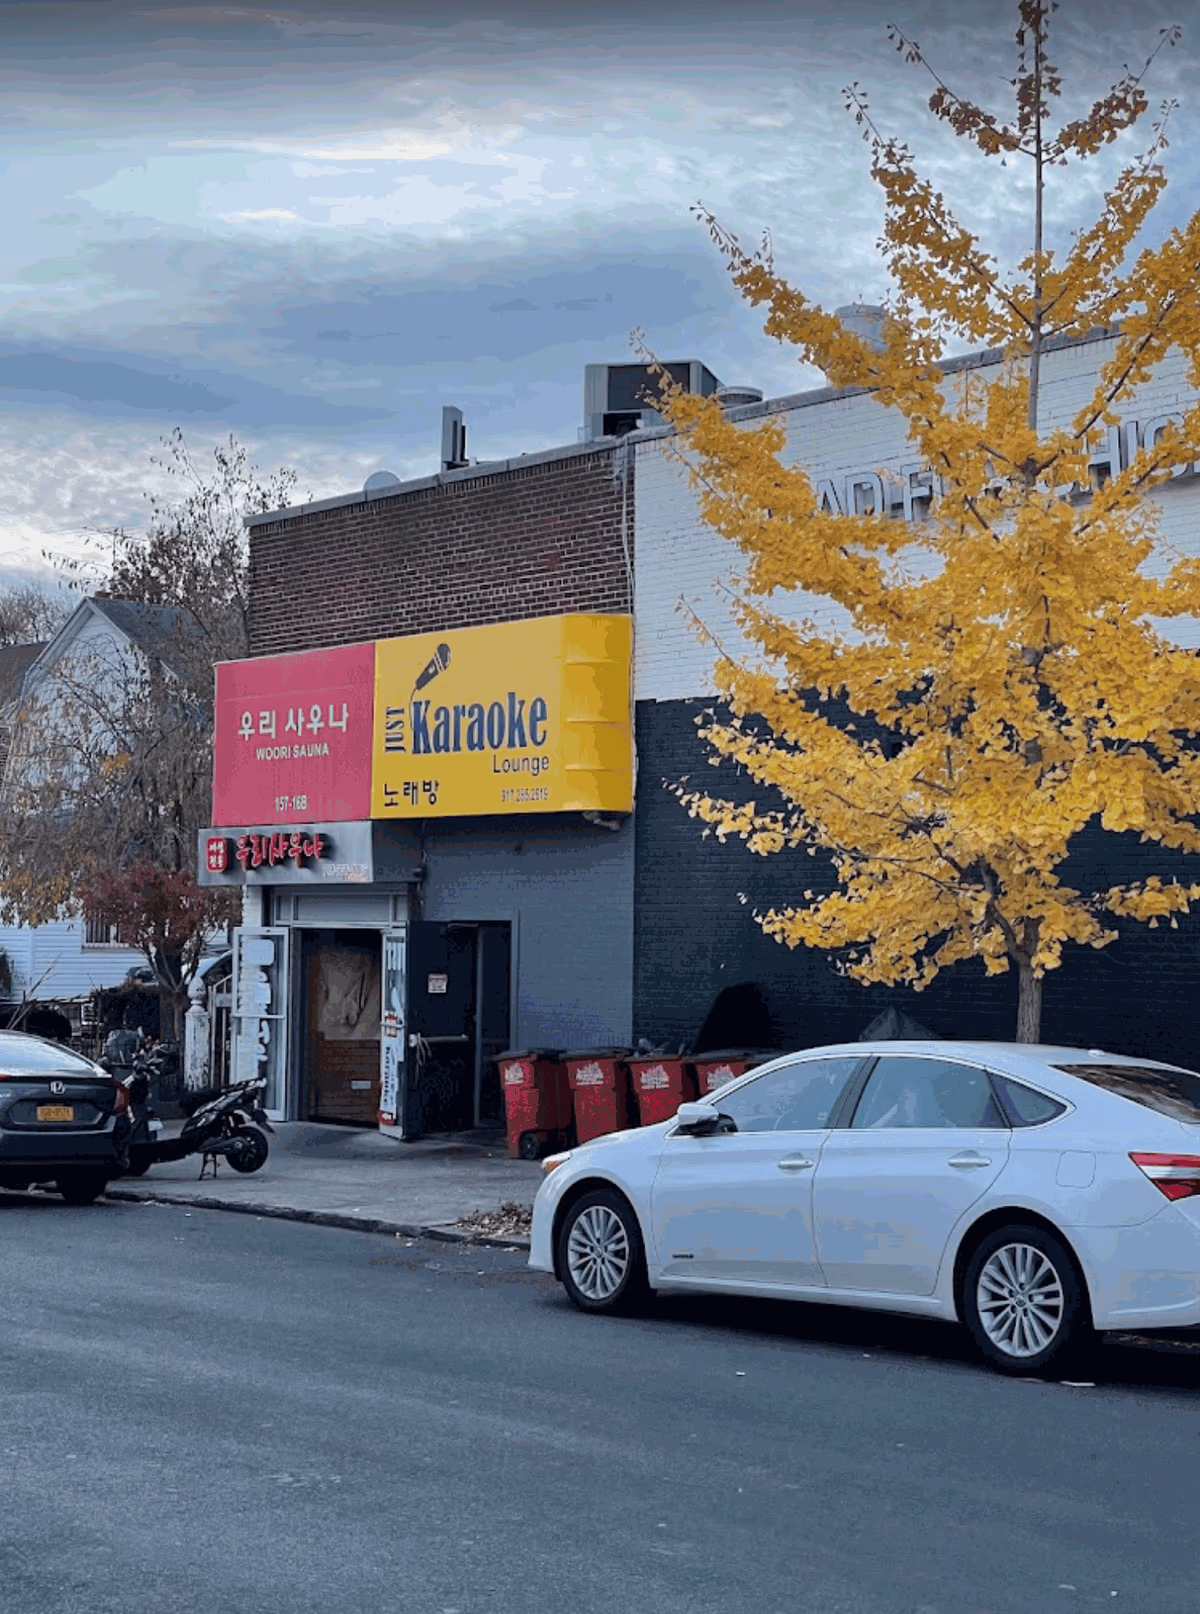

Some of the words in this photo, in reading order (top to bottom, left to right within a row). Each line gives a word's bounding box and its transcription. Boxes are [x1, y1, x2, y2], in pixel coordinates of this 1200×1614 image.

[237, 710, 276, 742] 우리
[284, 702, 349, 737] 사우나
[384, 706, 406, 753] JUST
[411, 691, 548, 755] Karaoke
[255, 745, 292, 761] WOORI
[292, 742, 330, 759] SAUNA
[492, 753, 550, 777] Lounge
[383, 779, 440, 808] 노래방
